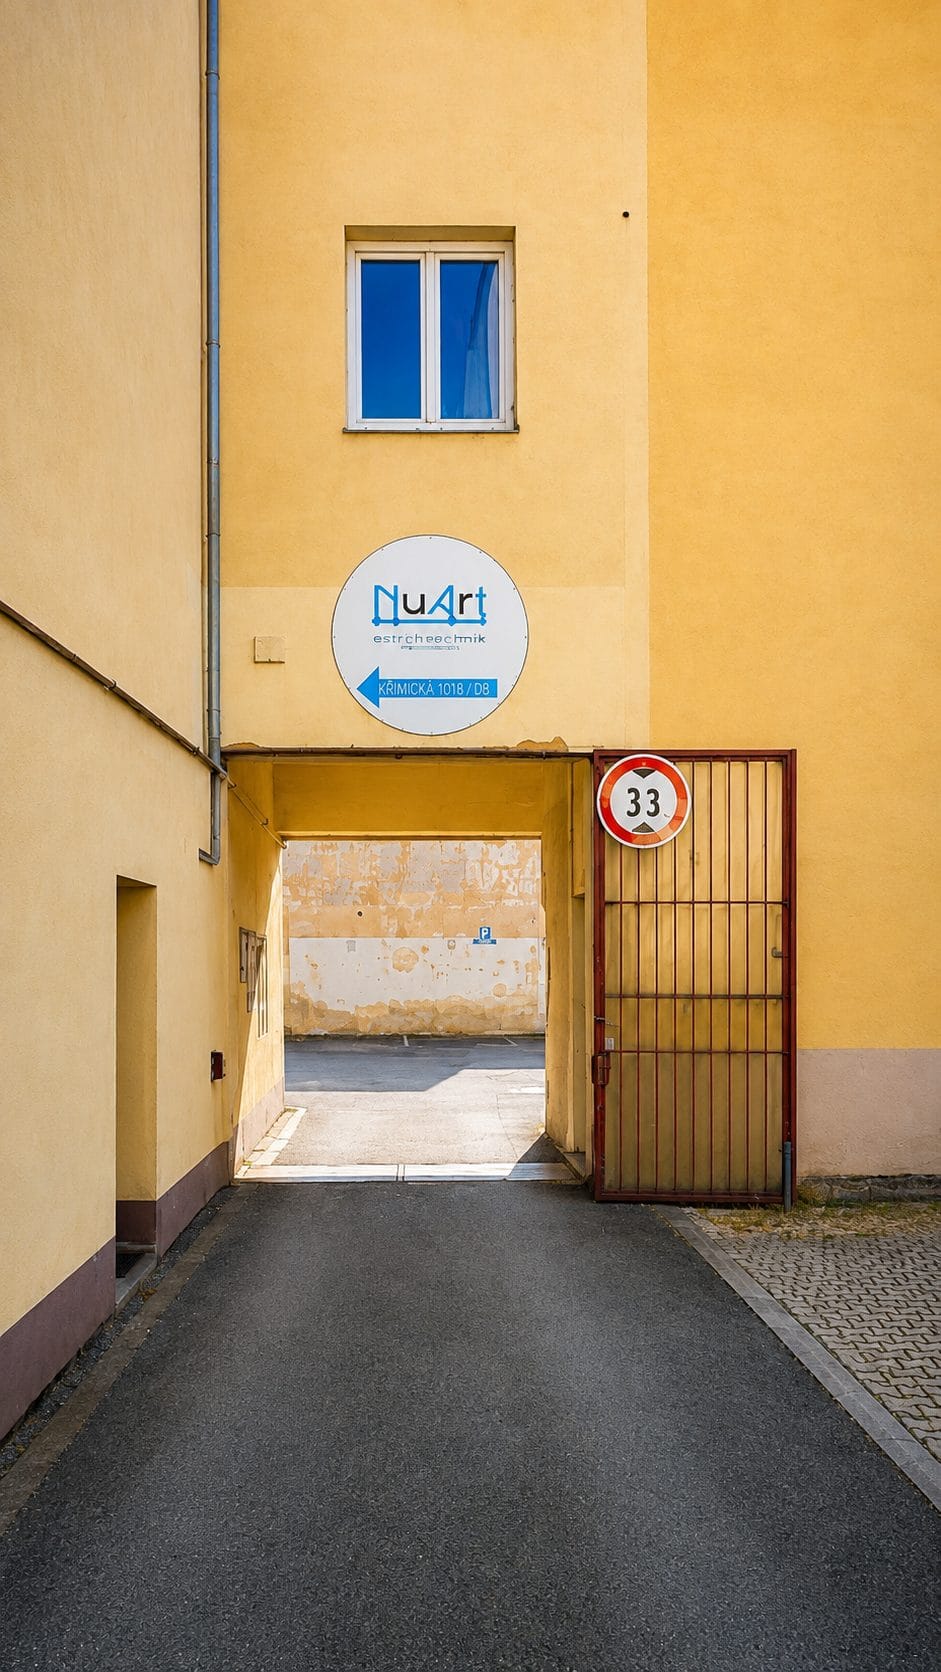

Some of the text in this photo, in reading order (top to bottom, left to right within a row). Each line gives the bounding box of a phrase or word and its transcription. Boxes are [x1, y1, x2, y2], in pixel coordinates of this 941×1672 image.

[373, 584, 487, 624] NuArt
[438, 682, 464, 695] 1018
[474, 682, 490, 695] D8
[481, 927, 489, 940] P
